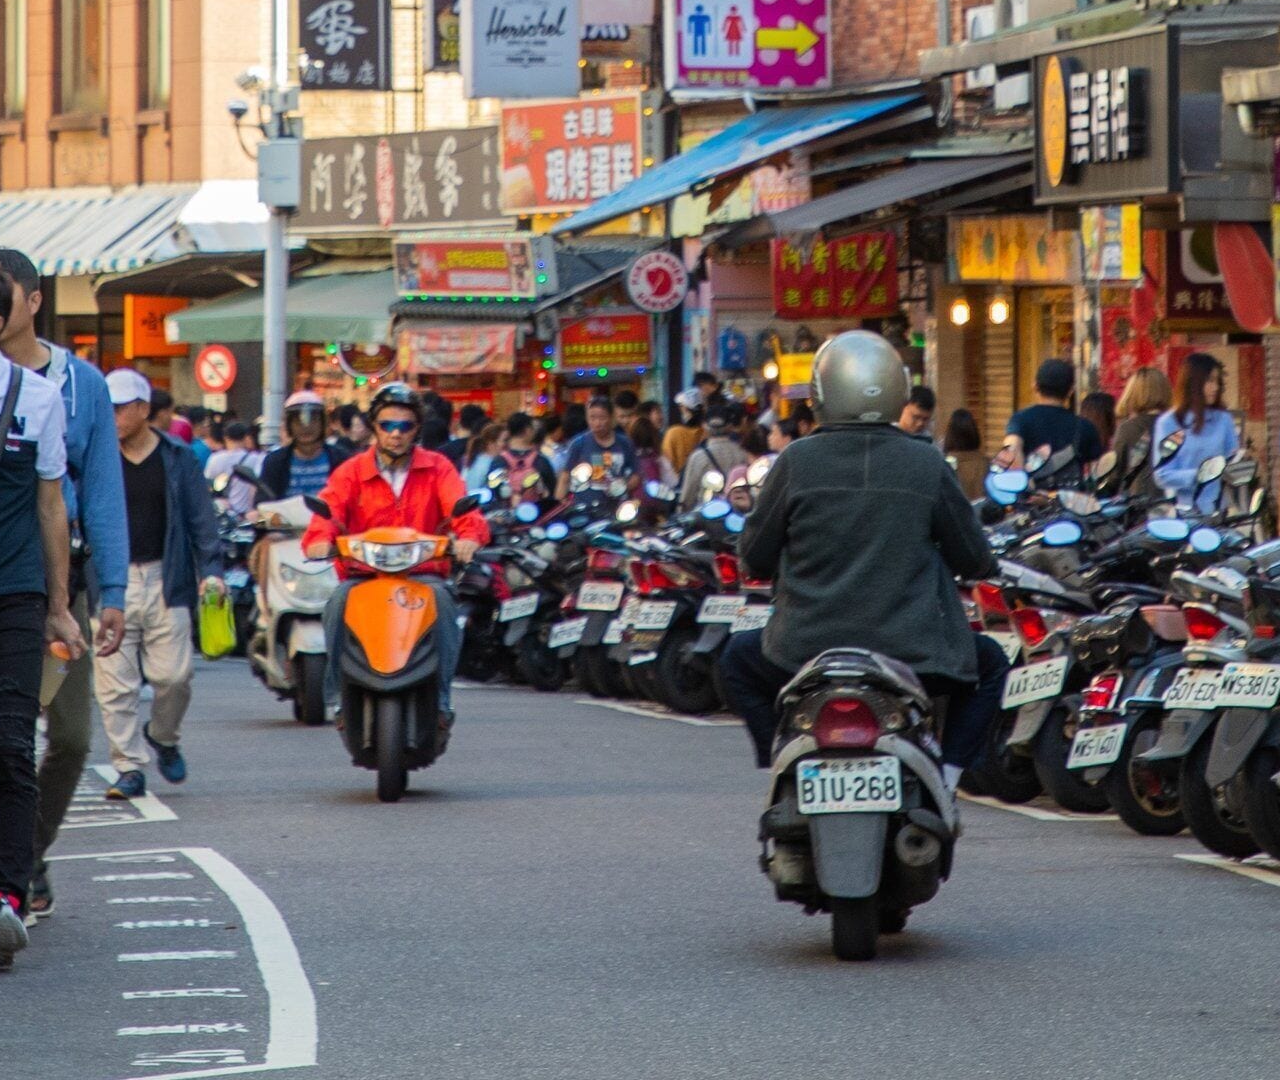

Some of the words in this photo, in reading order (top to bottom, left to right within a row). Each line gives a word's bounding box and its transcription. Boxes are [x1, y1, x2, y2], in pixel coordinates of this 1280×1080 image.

[485, 4, 569, 45] Herschel
[563, 106, 614, 141] 古早味
[545, 141, 634, 202] 現烤蛋糕
[801, 776, 897, 804] BIU-268
